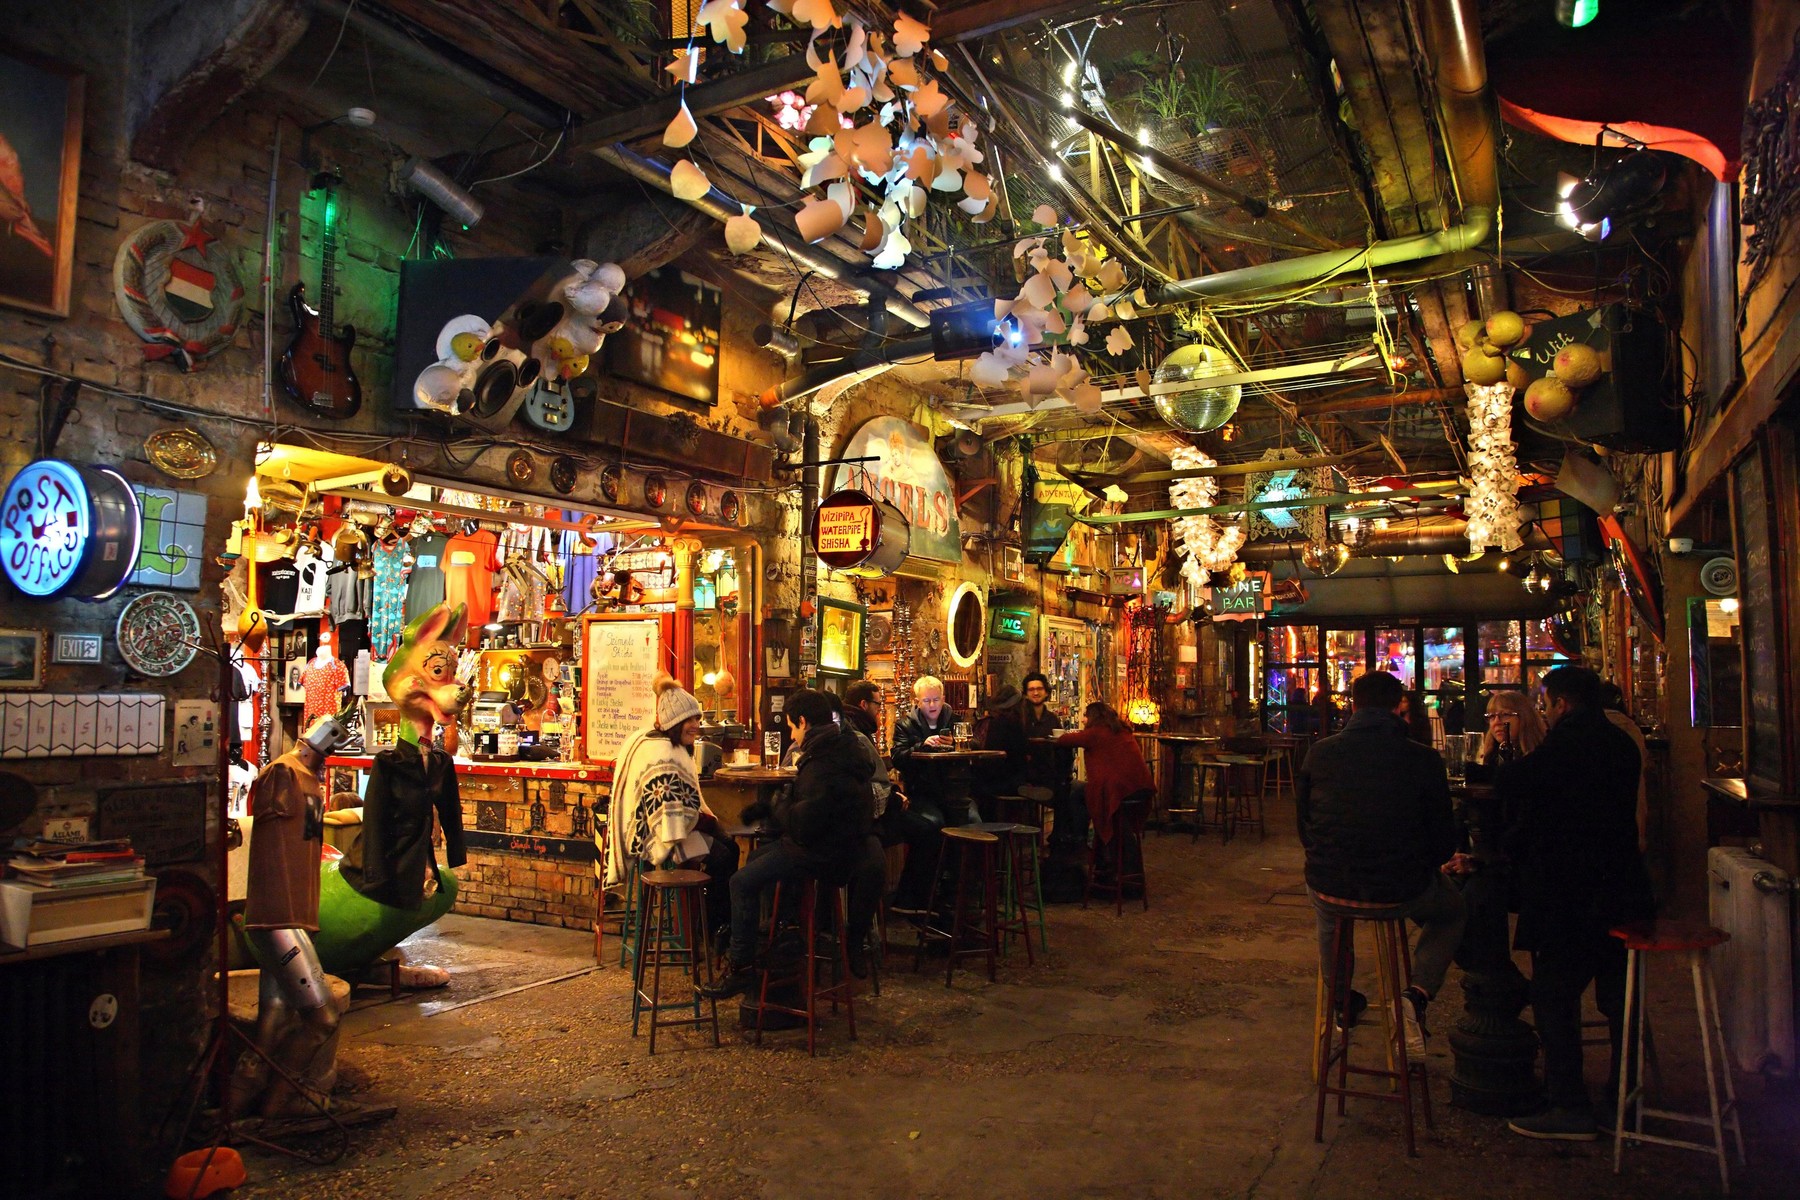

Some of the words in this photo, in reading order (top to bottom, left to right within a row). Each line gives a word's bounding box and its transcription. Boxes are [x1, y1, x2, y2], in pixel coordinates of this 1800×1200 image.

[1535, 332, 1575, 364] Wifi
[5, 474, 75, 539] POST
[1113, 575, 1131, 585] WC
[1223, 597, 1256, 609] BAR
[1002, 618, 1021, 630] WC
[61, 639, 84, 658] EXIT
[8, 717, 134, 738] Shisha
